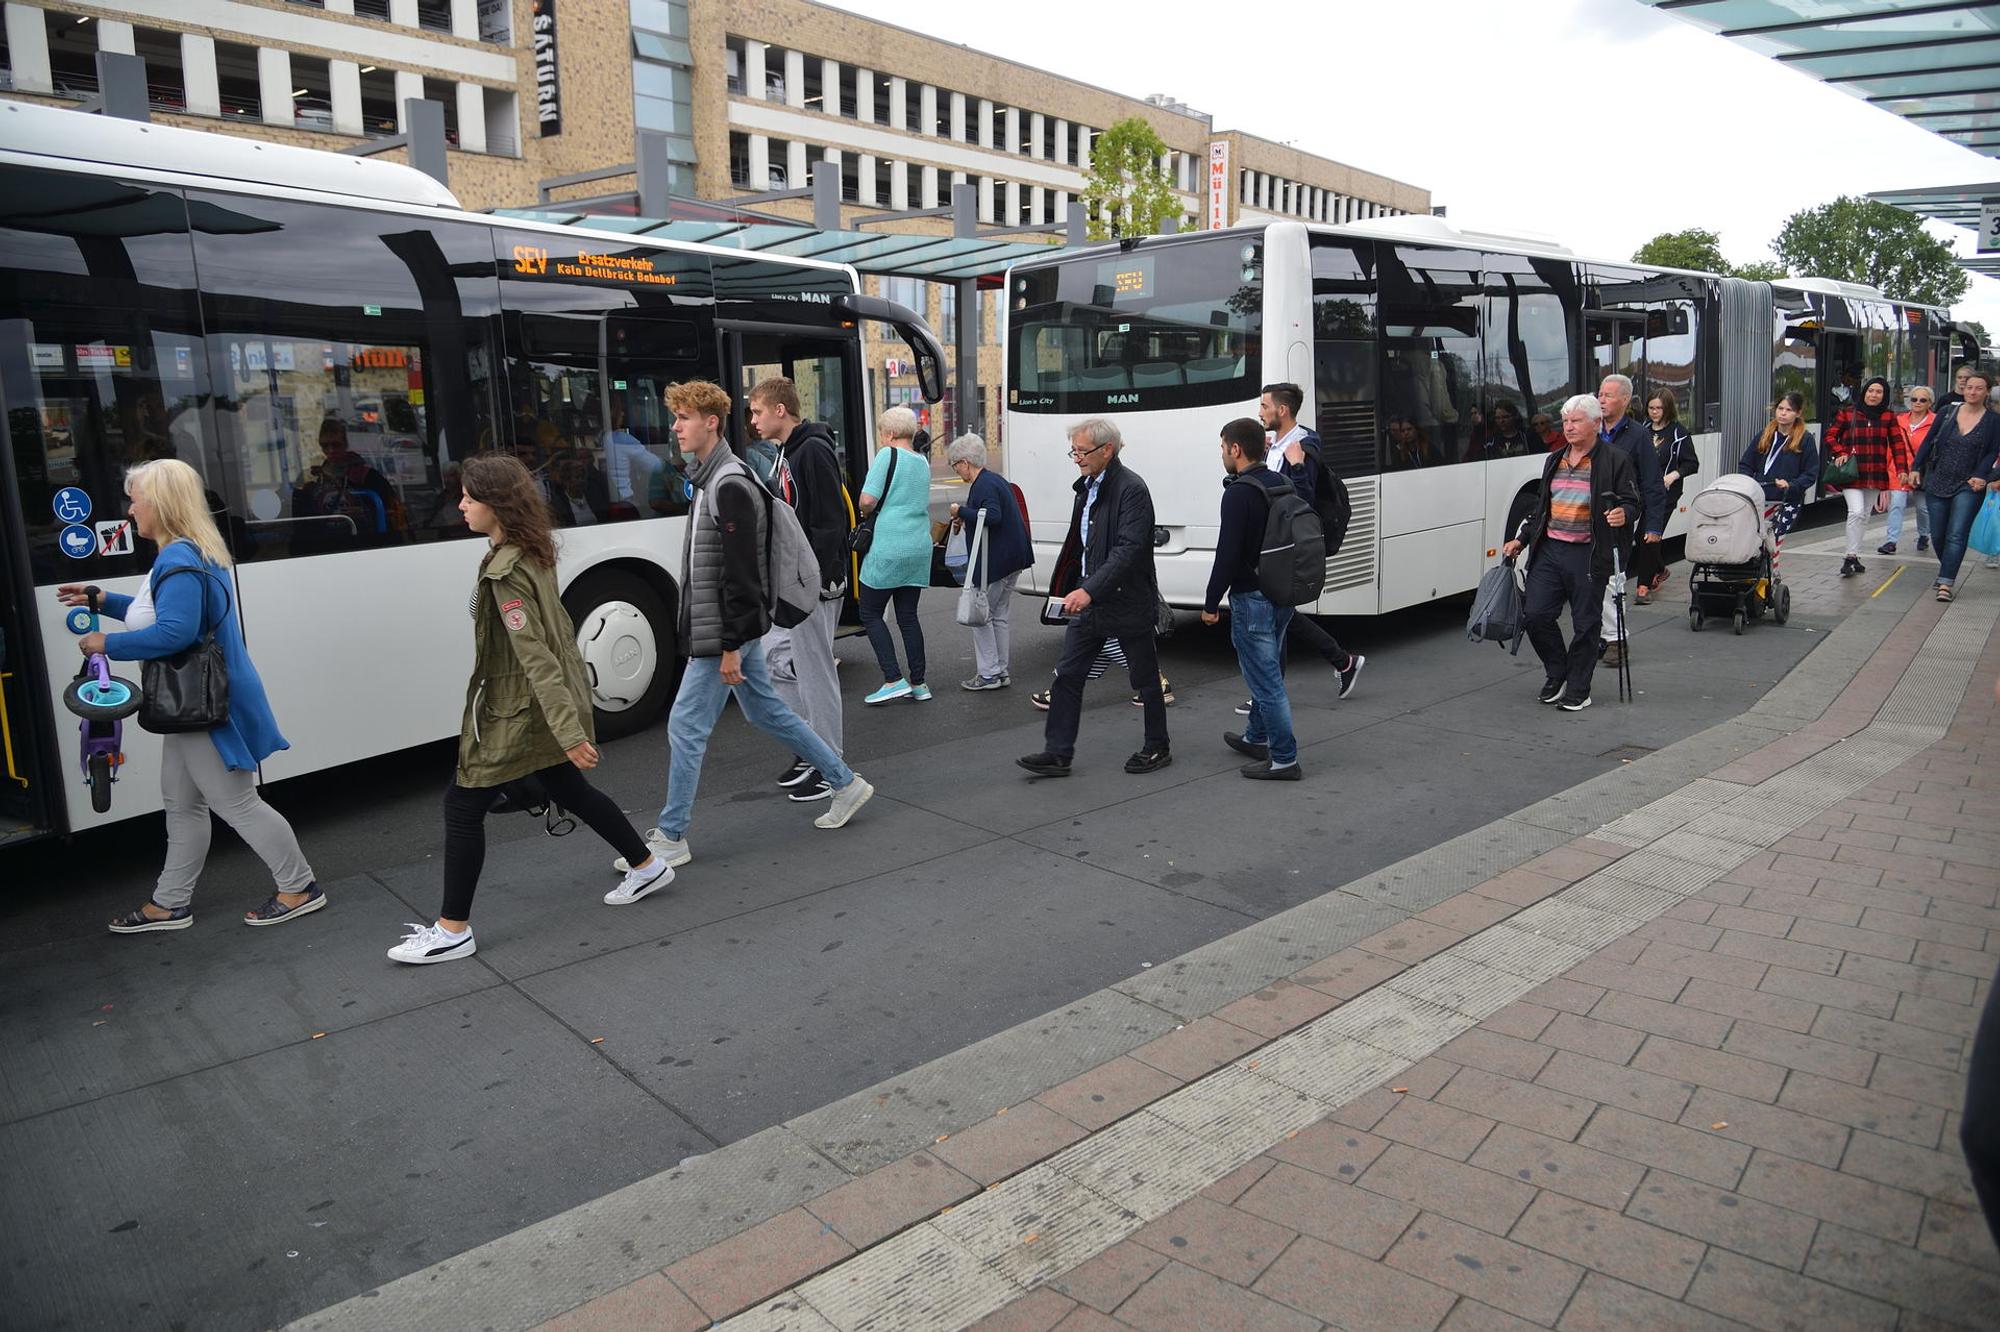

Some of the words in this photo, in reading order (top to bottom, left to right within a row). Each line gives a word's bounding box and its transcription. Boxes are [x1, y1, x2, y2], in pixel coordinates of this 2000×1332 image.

[534, 14, 557, 122] SATURN
[1211, 162, 1224, 230] Mülle
[513, 245, 548, 274] SEV
[578, 251, 655, 271] Ersatzverkehr
[557, 263, 583, 276] Köln
[585, 267, 635, 282] Dellbrück
[637, 272, 677, 285] Bahnhof
[801, 292, 831, 304] MAN
[1107, 393, 1139, 404] MAN
